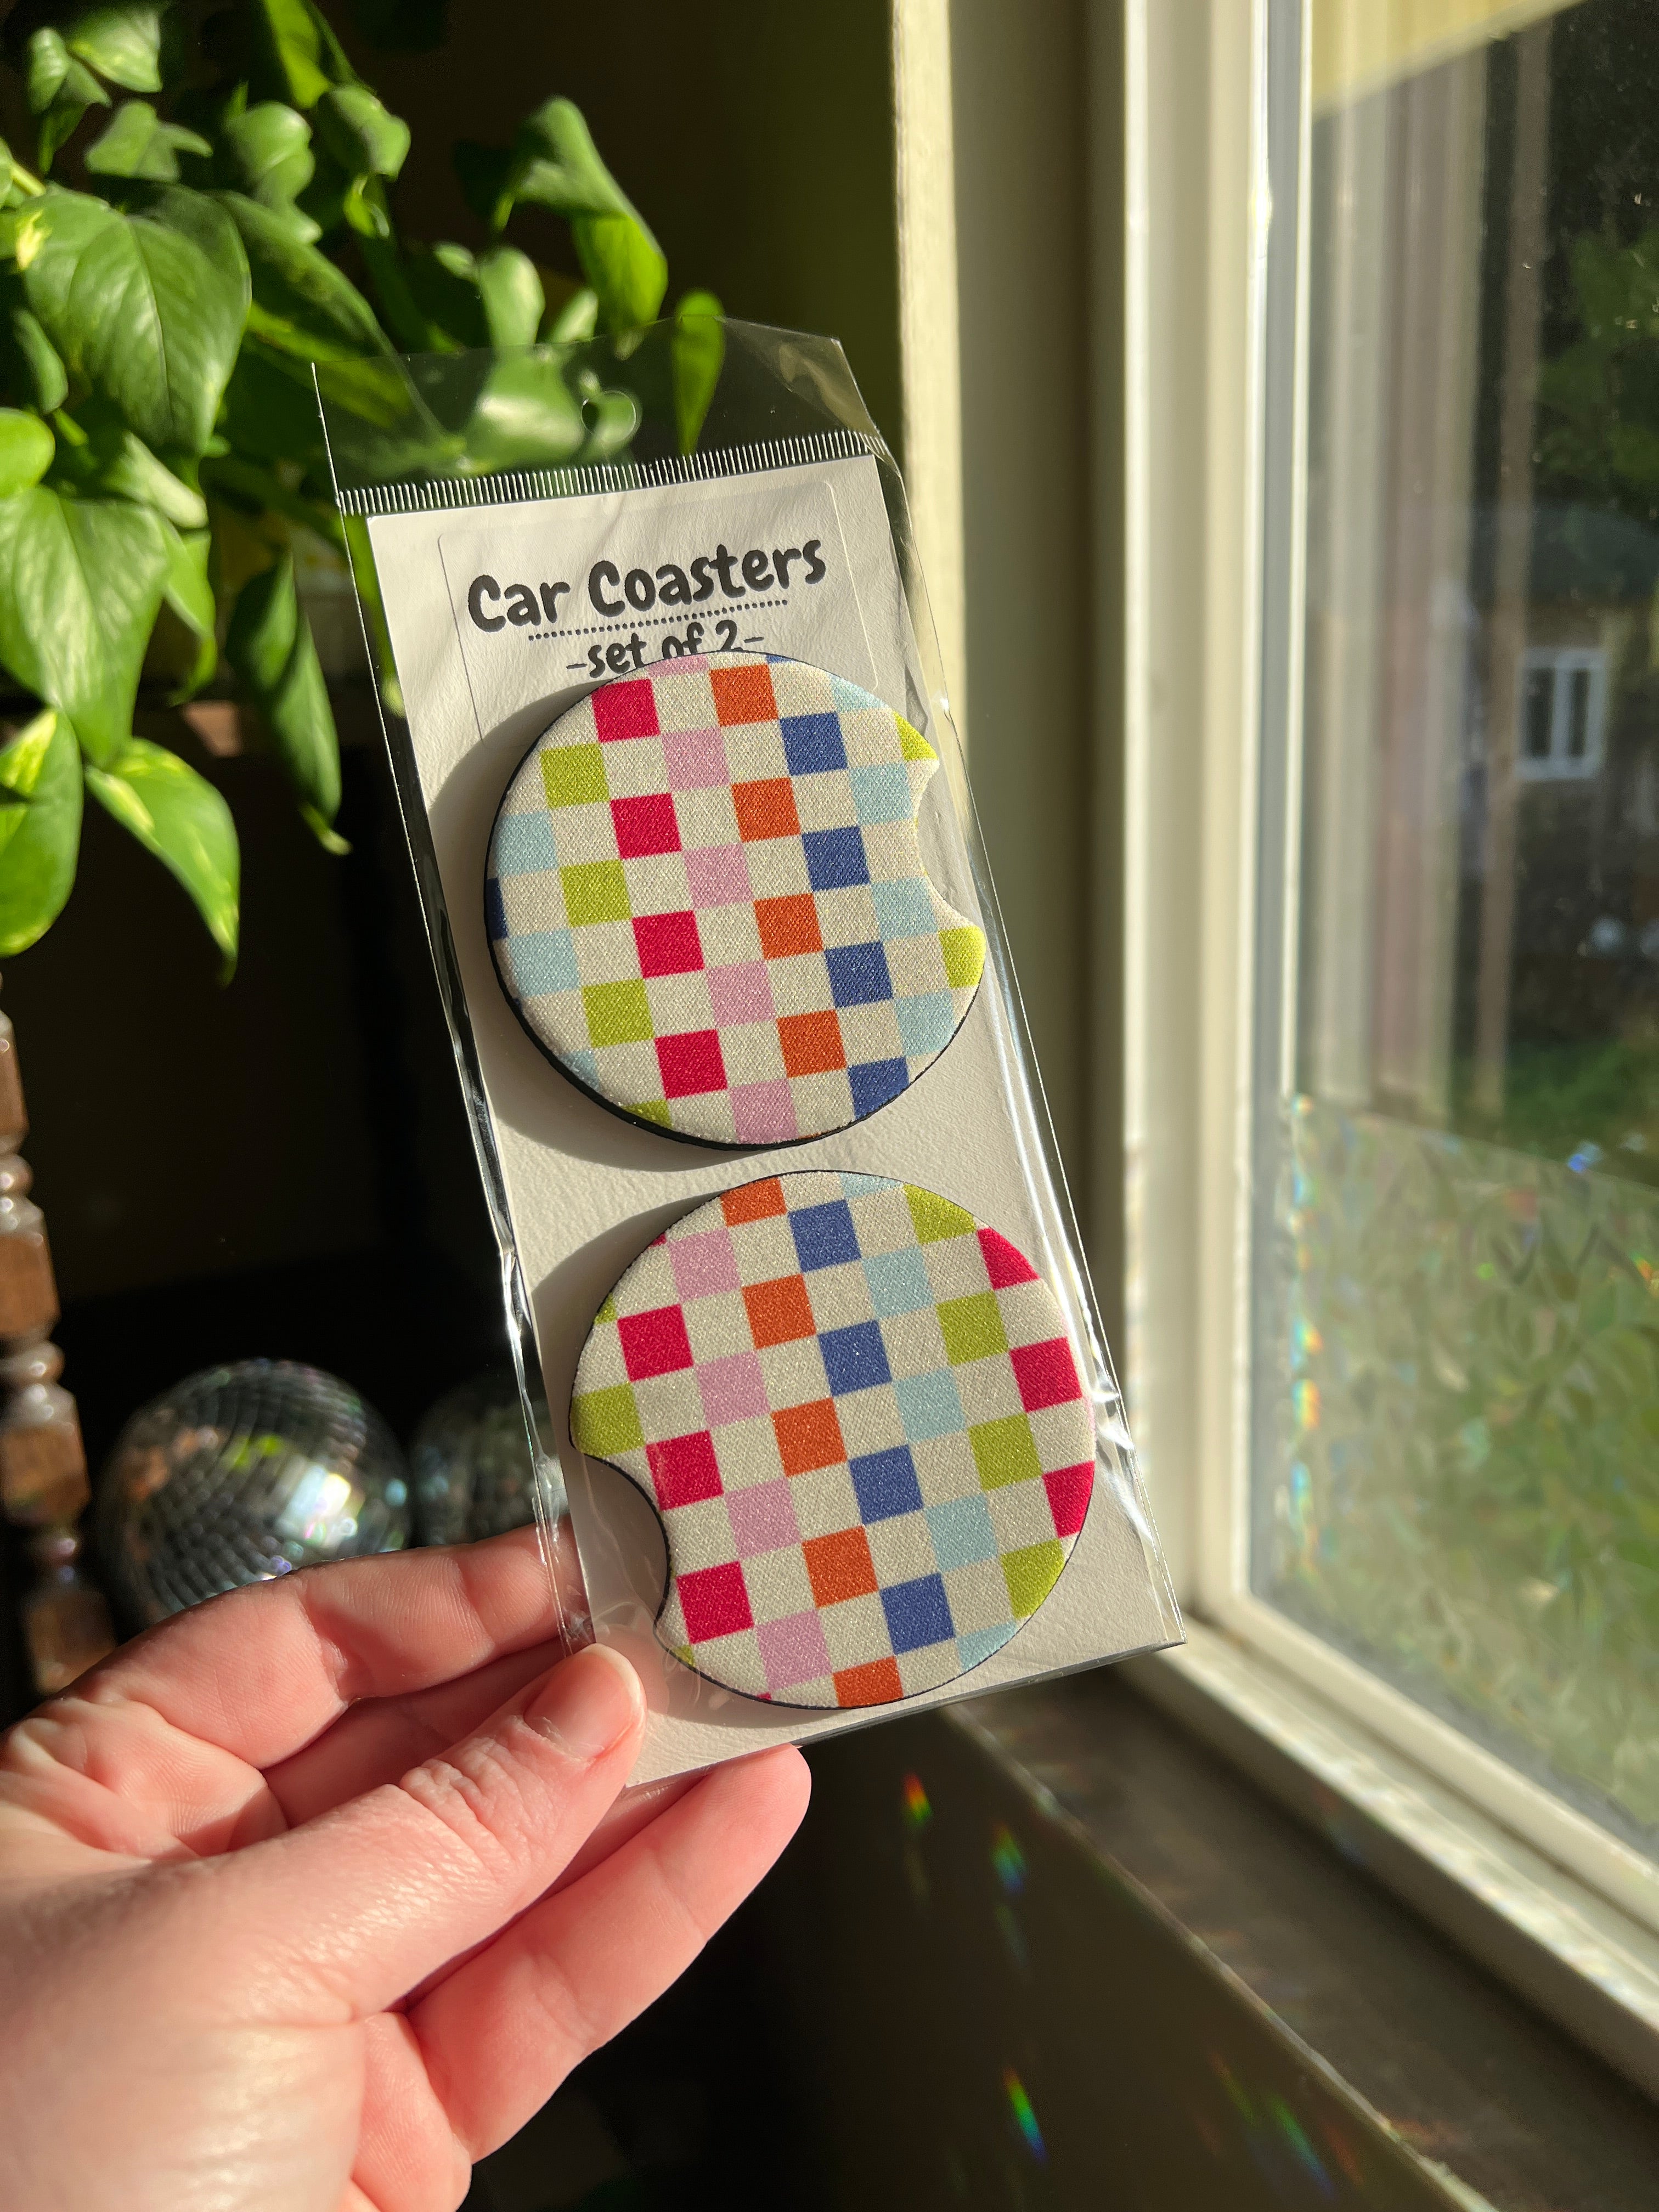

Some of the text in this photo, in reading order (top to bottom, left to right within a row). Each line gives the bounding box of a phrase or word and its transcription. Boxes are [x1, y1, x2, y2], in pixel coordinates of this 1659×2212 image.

[467, 539, 826, 633] Car Coasters
[662, 622, 704, 658] of
